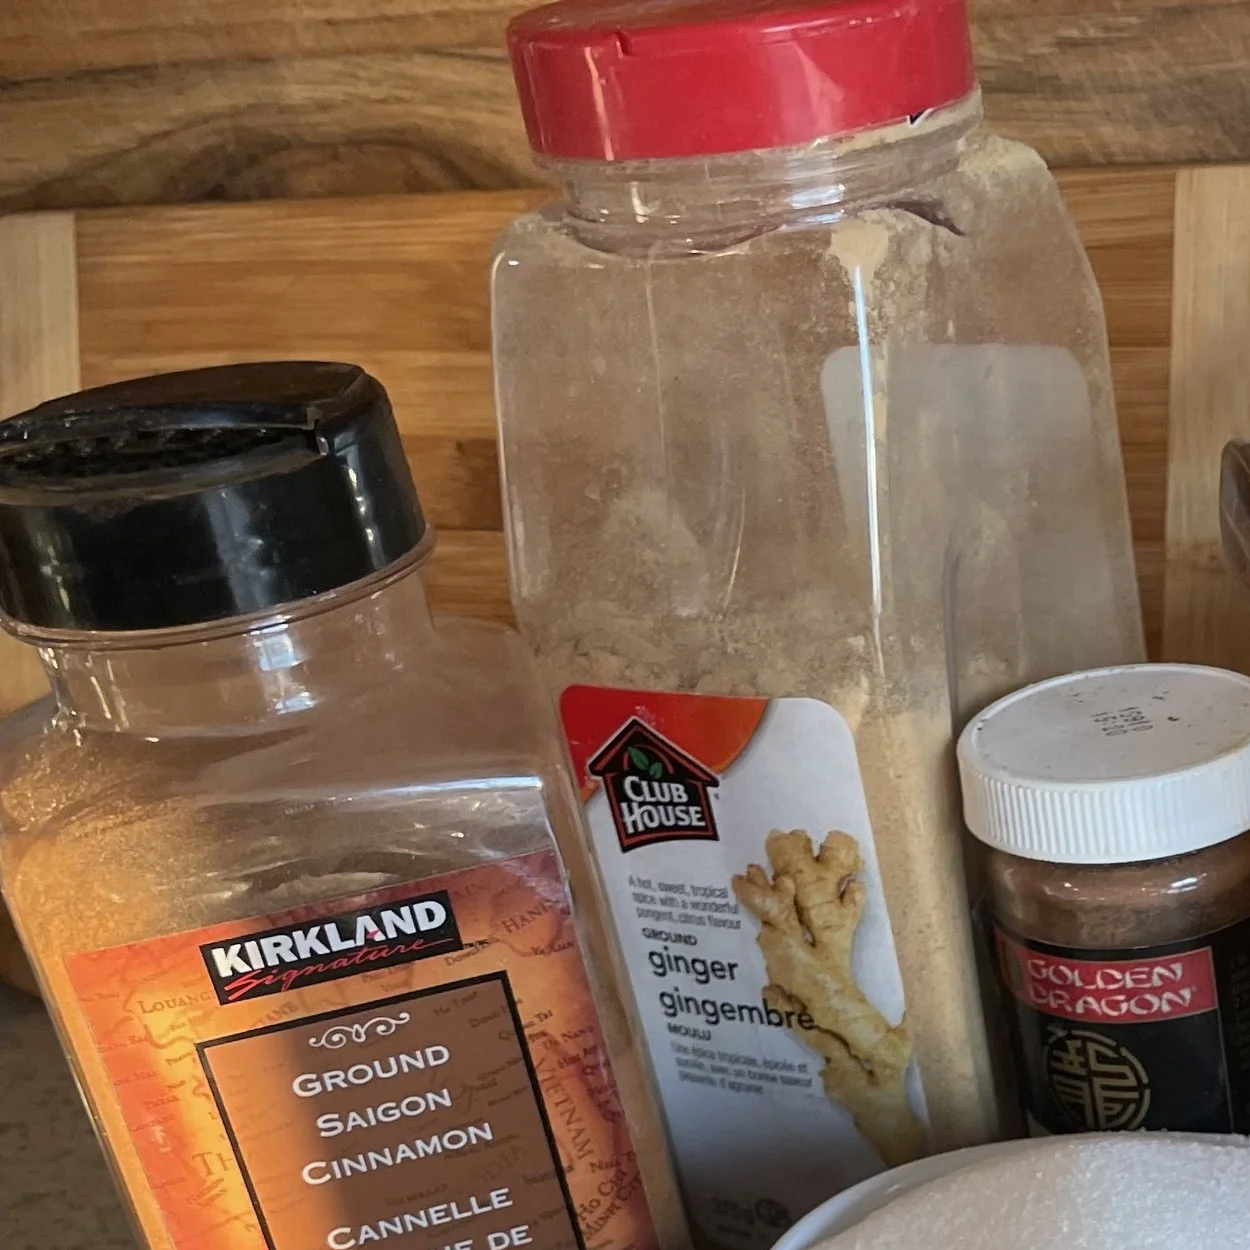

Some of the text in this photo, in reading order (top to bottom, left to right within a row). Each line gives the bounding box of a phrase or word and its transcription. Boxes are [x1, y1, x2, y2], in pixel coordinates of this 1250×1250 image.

[624, 775, 688, 804] CLUB
[621, 801, 706, 835] HOUSE
[211, 899, 447, 978] KIRKLAND
[224, 937, 454, 1001] Signature
[648, 946, 739, 984] ginger
[1027, 959, 1183, 990] GOLDEN
[659, 986, 815, 1030] gingembre
[1028, 986, 1192, 1017] DRAGON
[667, 1023, 711, 1041] MOULU
[292, 1044, 450, 1098] GROUND
[316, 1088, 452, 1138] SAIGON
[301, 1122, 493, 1186] CINNAMON
[326, 1188, 513, 1250] CANNELLE
